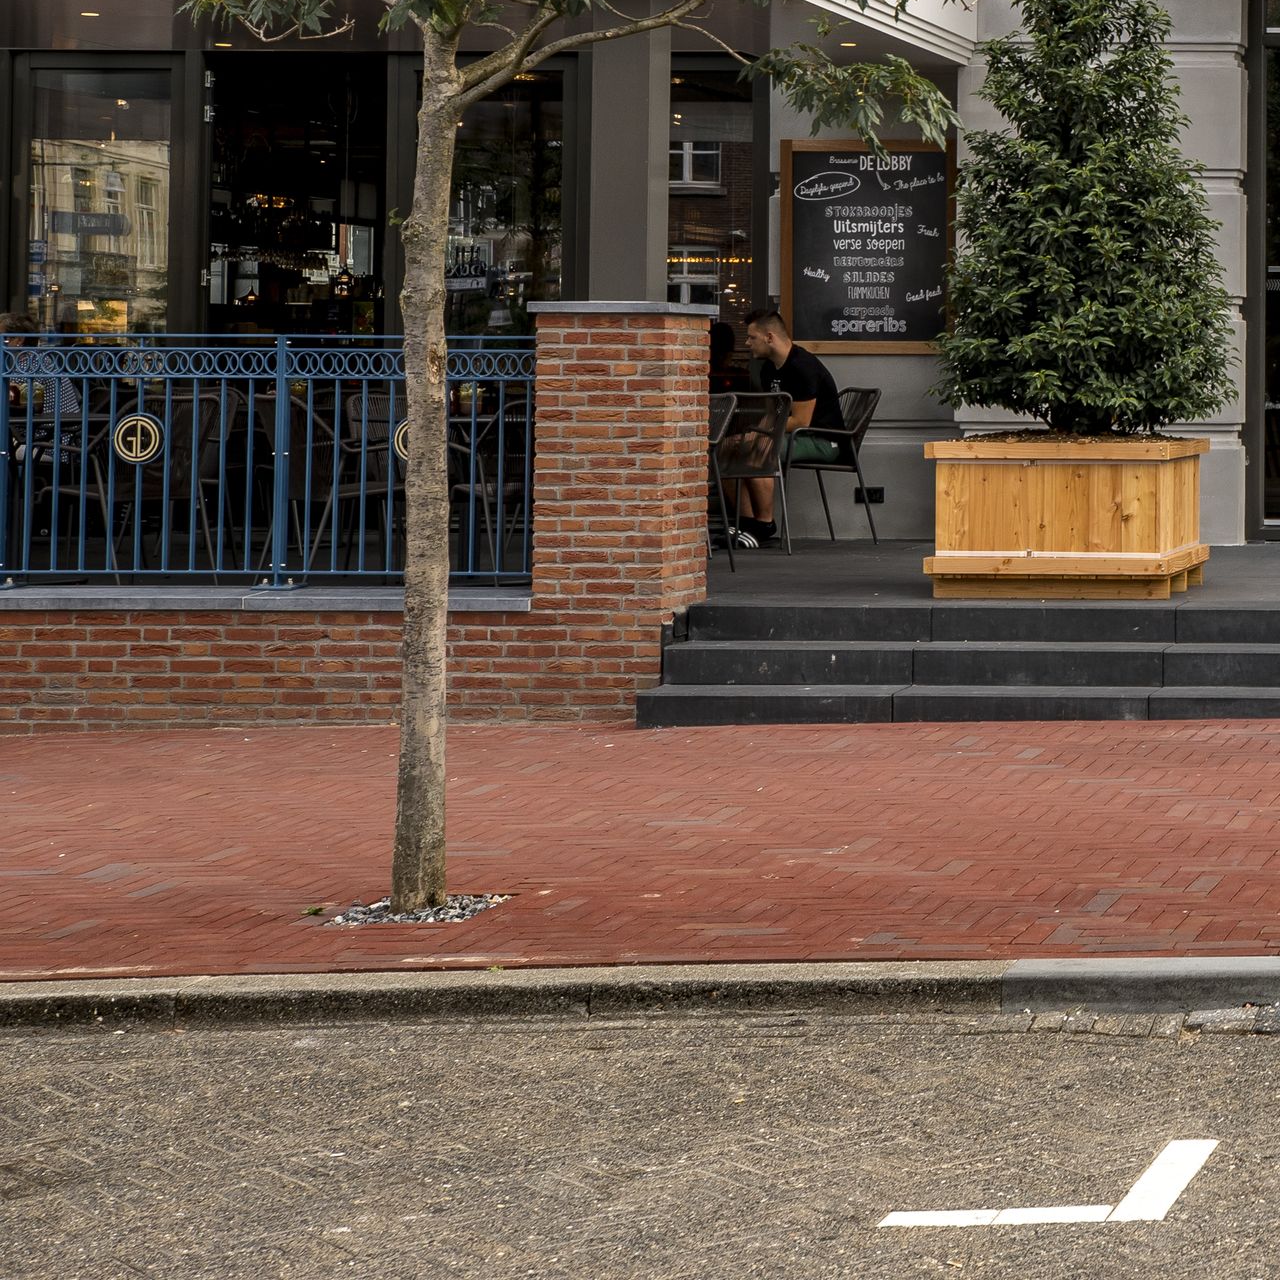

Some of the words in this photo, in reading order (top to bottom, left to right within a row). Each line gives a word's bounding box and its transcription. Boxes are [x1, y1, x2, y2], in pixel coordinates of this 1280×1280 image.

[860, 155, 874, 171] DE
[877, 155, 913, 171] LOBBY
[829, 177, 855, 193] geopend
[893, 179, 909, 191] The
[909, 177, 927, 191] place
[927, 175, 936, 184] to
[936, 172, 945, 183] be
[833, 219, 904, 237] Uitsmijters
[917, 224, 940, 237] Fresh
[833, 239, 862, 250] verse
[866, 239, 905, 254] soepen
[833, 256, 905, 267] BEEFBURGERS
[803, 266, 831, 283] Healthy
[843, 271, 895, 283] SALADES
[847, 286, 890, 300] FLAMMKUCHEN
[905, 289, 925, 302] Good
[925, 285, 943, 301] food
[843, 305, 895, 319] carpaccio
[831, 317, 907, 336] spareribs
